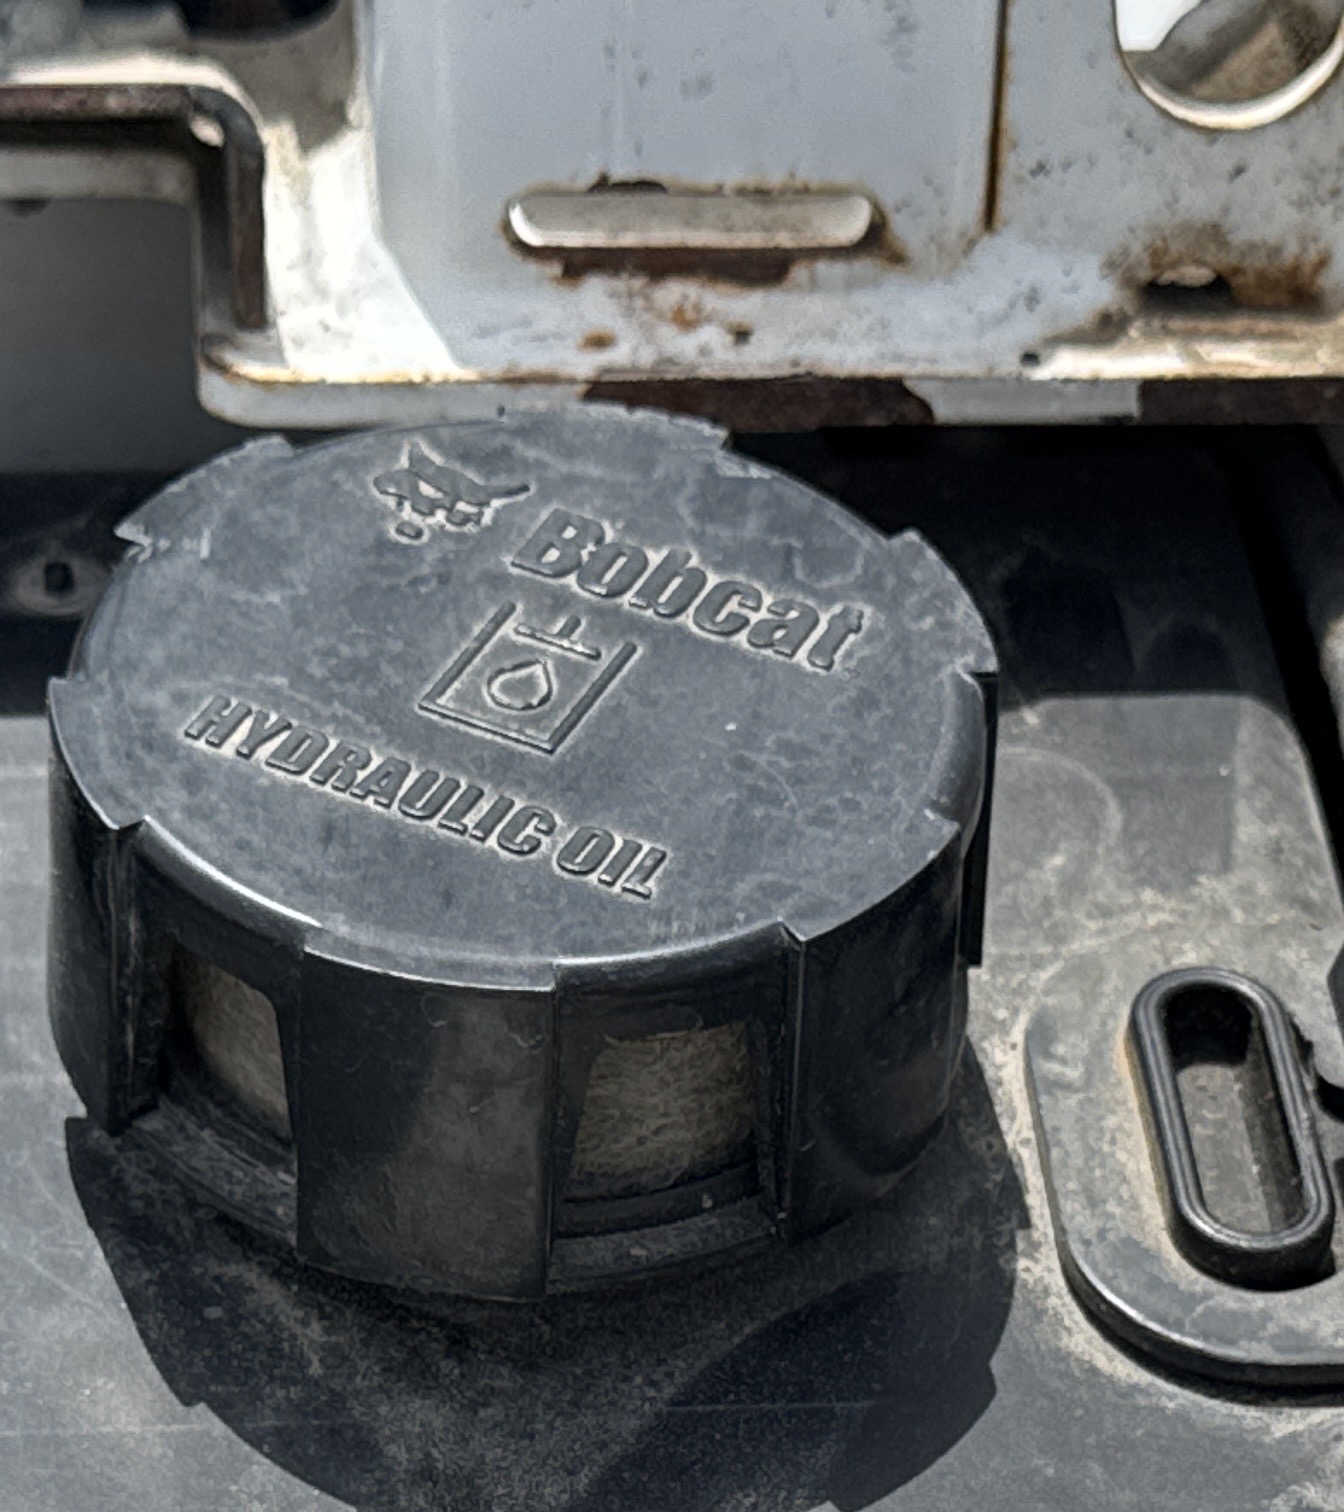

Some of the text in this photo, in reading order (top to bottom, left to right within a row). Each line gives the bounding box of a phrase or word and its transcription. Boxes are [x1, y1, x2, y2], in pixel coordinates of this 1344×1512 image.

[509, 507, 864, 672] Bobcat
[184, 695, 667, 900] HYDRAULIC OIL
